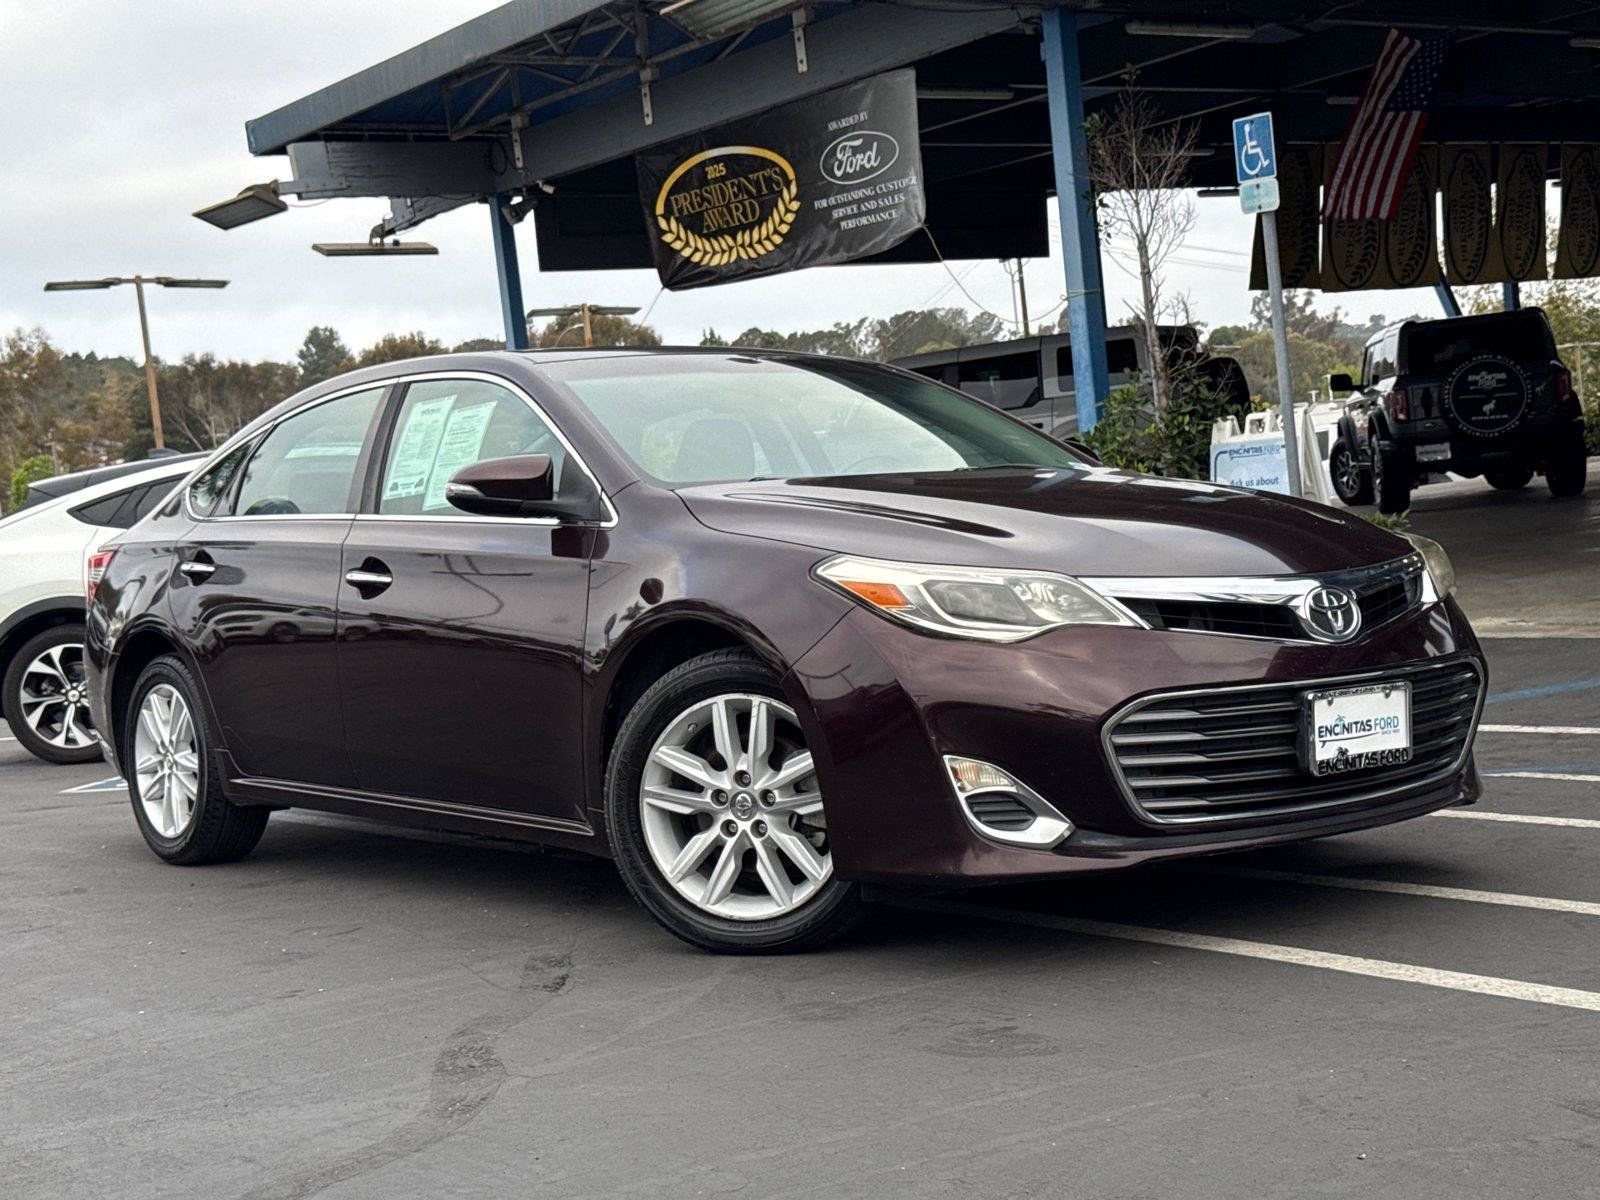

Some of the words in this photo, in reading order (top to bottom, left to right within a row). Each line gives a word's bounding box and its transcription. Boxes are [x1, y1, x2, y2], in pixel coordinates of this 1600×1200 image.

[828, 113, 860, 132] AWARDED
[860, 110, 869, 122] BY
[834, 138, 881, 177] Ford
[705, 163, 727, 180] 2025
[670, 167, 783, 217] PRESIDENT'S
[814, 196, 828, 210] FOR
[828, 187, 875, 206] OUTSTANDING
[702, 199, 760, 233] AWARD
[832, 203, 859, 219] SERVICE
[860, 199, 878, 213] AND
[878, 193, 905, 207] SALES
[840, 209, 898, 230] PERFORMANCE
[1245, 479, 1255, 487] us
[1256, 477, 1279, 486] about
[1318, 717, 1373, 739] ENCINITAS
[1374, 716, 1399, 731] FORD
[1318, 750, 1378, 775] ENCINITAS
[1379, 748, 1408, 764] FORD
